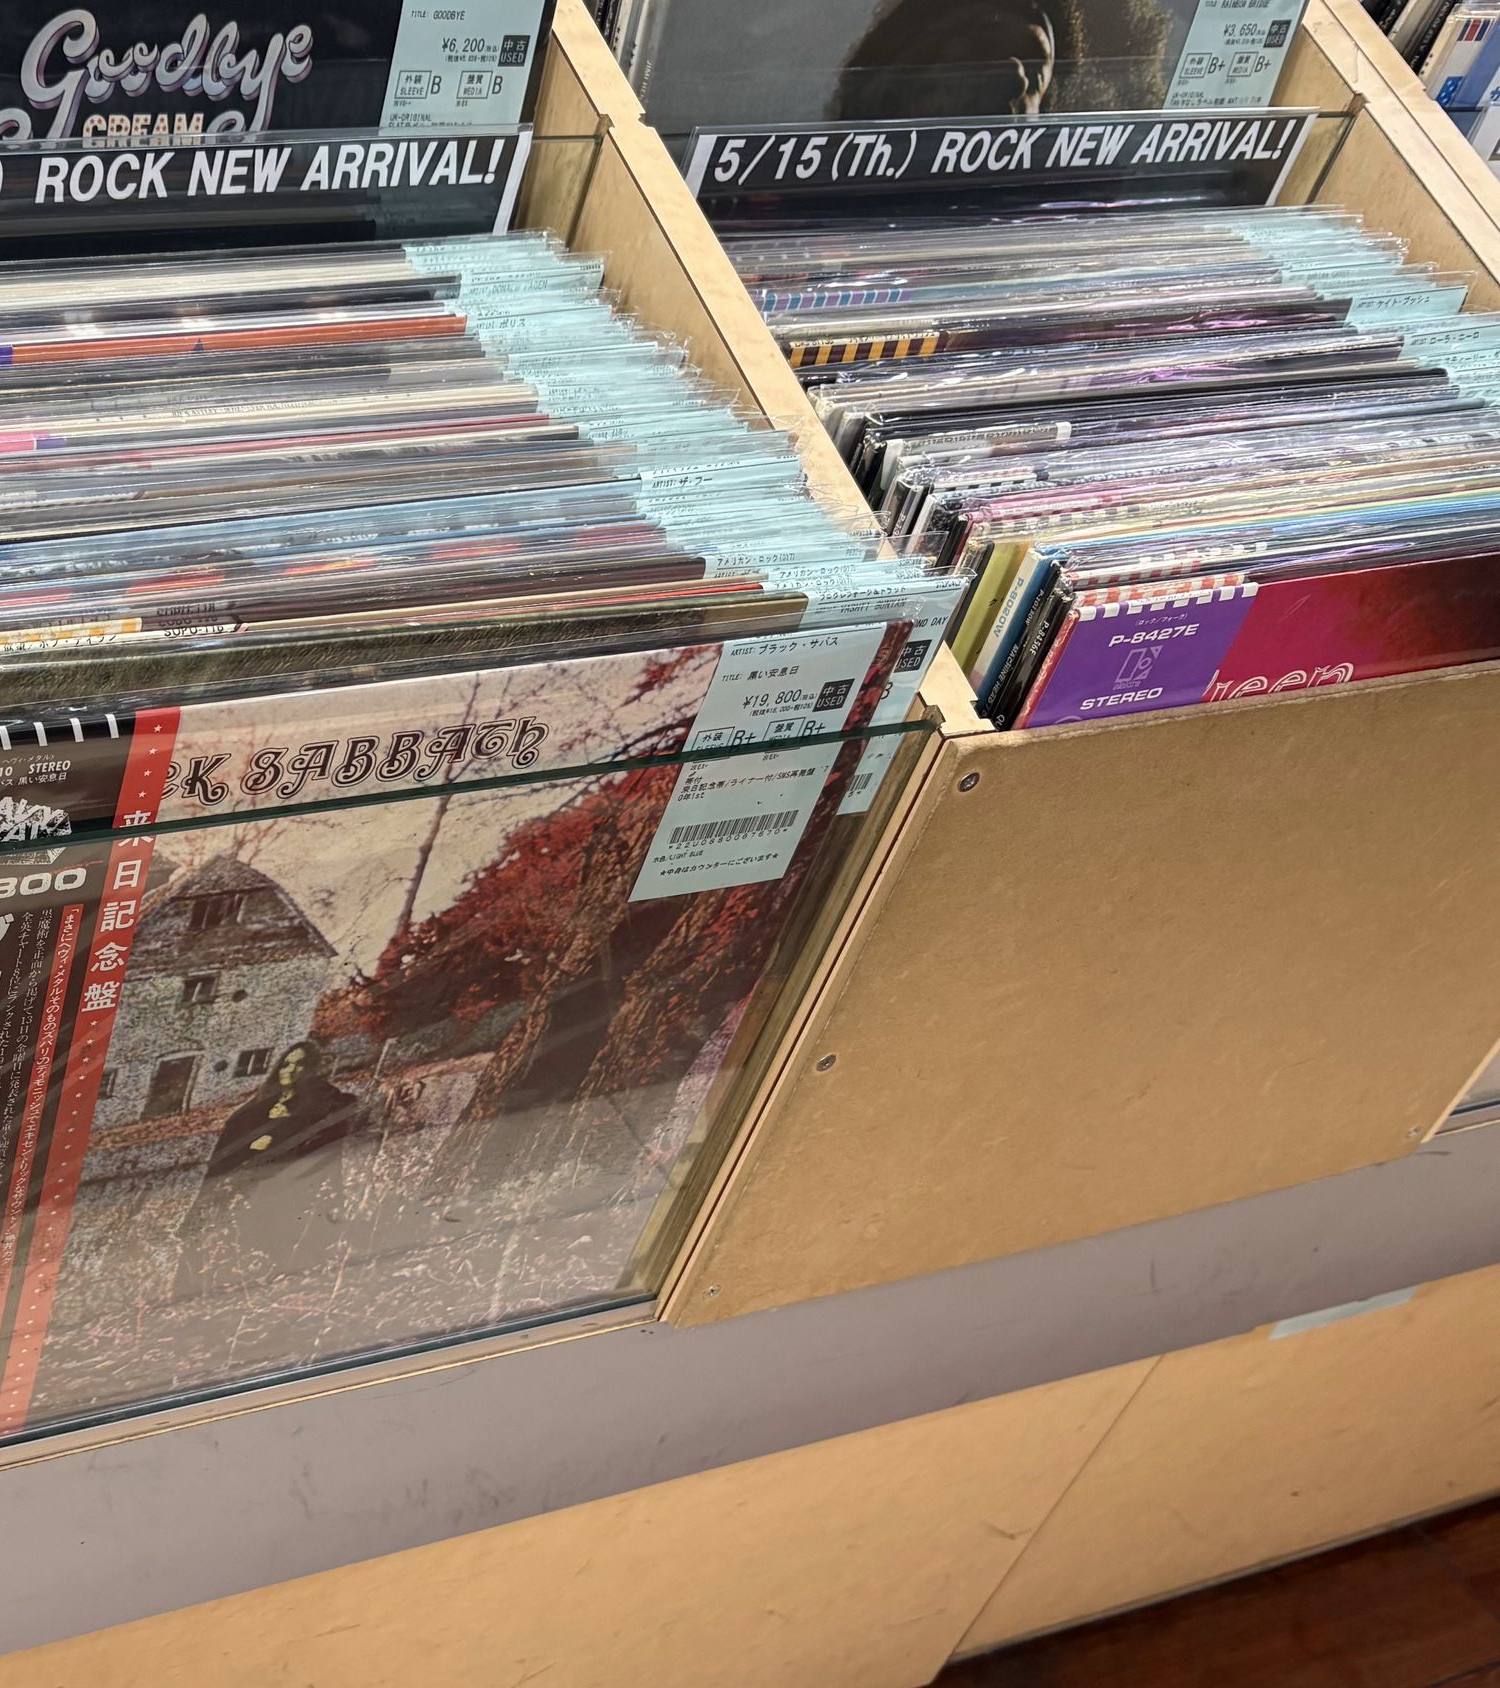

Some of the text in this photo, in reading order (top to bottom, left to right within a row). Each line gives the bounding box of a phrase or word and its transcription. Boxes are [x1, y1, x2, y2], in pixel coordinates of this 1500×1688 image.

[433, 11, 465, 20] GOODBYE
[1223, 24, 1258, 37] ¥3,650
[442, 38, 485, 53] ¥6,200
[504, 40, 526, 50] 中古
[501, 53, 524, 63] USED
[1208, 57, 1225, 73] B+
[1255, 56, 1271, 72] B+
[21, 9, 313, 142] Goodbye
[405, 75, 421, 84] 外装
[400, 87, 424, 96] SLEEVE
[431, 76, 442, 95] B
[492, 76, 503, 95] B
[82, 113, 203, 147] CREAM
[714, 118, 1296, 185] 5/15 (Th.) ROCK NEW ARRIVAL!
[35, 153, 170, 204] ROCK
[188, 148, 290, 197] NEW
[300, 139, 504, 192] ARRIVAL!
[679, 476, 713, 487] ザ・フー
[931, 616, 948, 627] DAY
[1108, 623, 1200, 648] P-8427E
[730, 635, 839, 657] ARTIST: ブラック・サバス
[722, 665, 800, 682] TITLE: 黒い安息日
[823, 684, 850, 695] 中古
[1204, 661, 1355, 703] een
[743, 689, 802, 709] ¥19,800
[816, 695, 844, 708] USED
[1080, 687, 1164, 711] STEREO
[773, 722, 795, 734] 盤質
[802, 720, 826, 737] B+
[702, 732, 723, 743] 外装
[732, 729, 756, 747] B+
[28, 760, 72, 775] STEREO
[18, 772, 68, 787] 黒い安息日
[81, 810, 153, 1012] 来日記念盤
